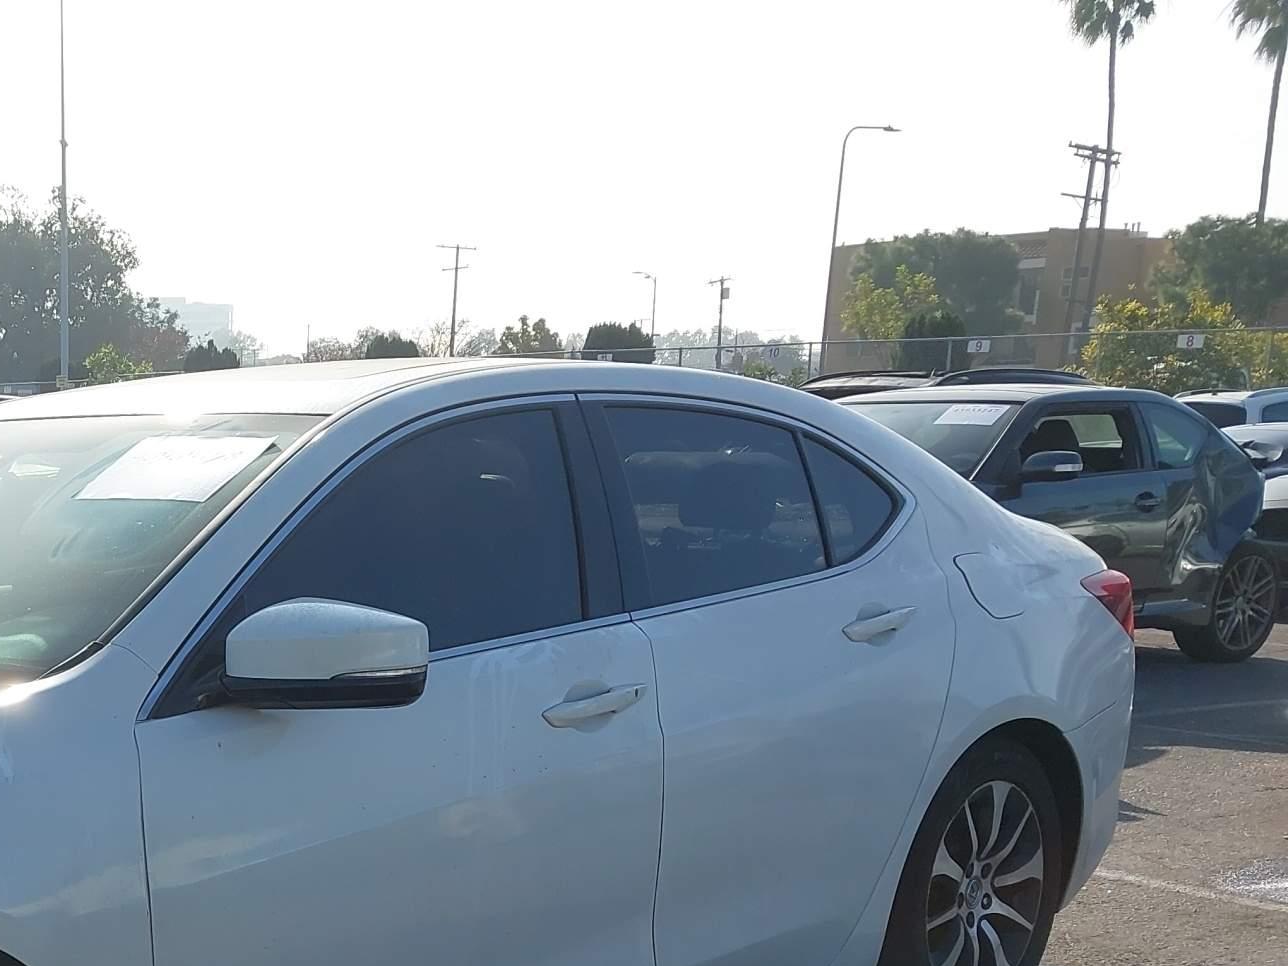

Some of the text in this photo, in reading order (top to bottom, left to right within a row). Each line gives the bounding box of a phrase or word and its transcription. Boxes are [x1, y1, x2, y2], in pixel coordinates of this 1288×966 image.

[975, 340, 983, 352] 9
[1186, 335, 1194, 347] 8
[768, 347, 780, 358] 10
